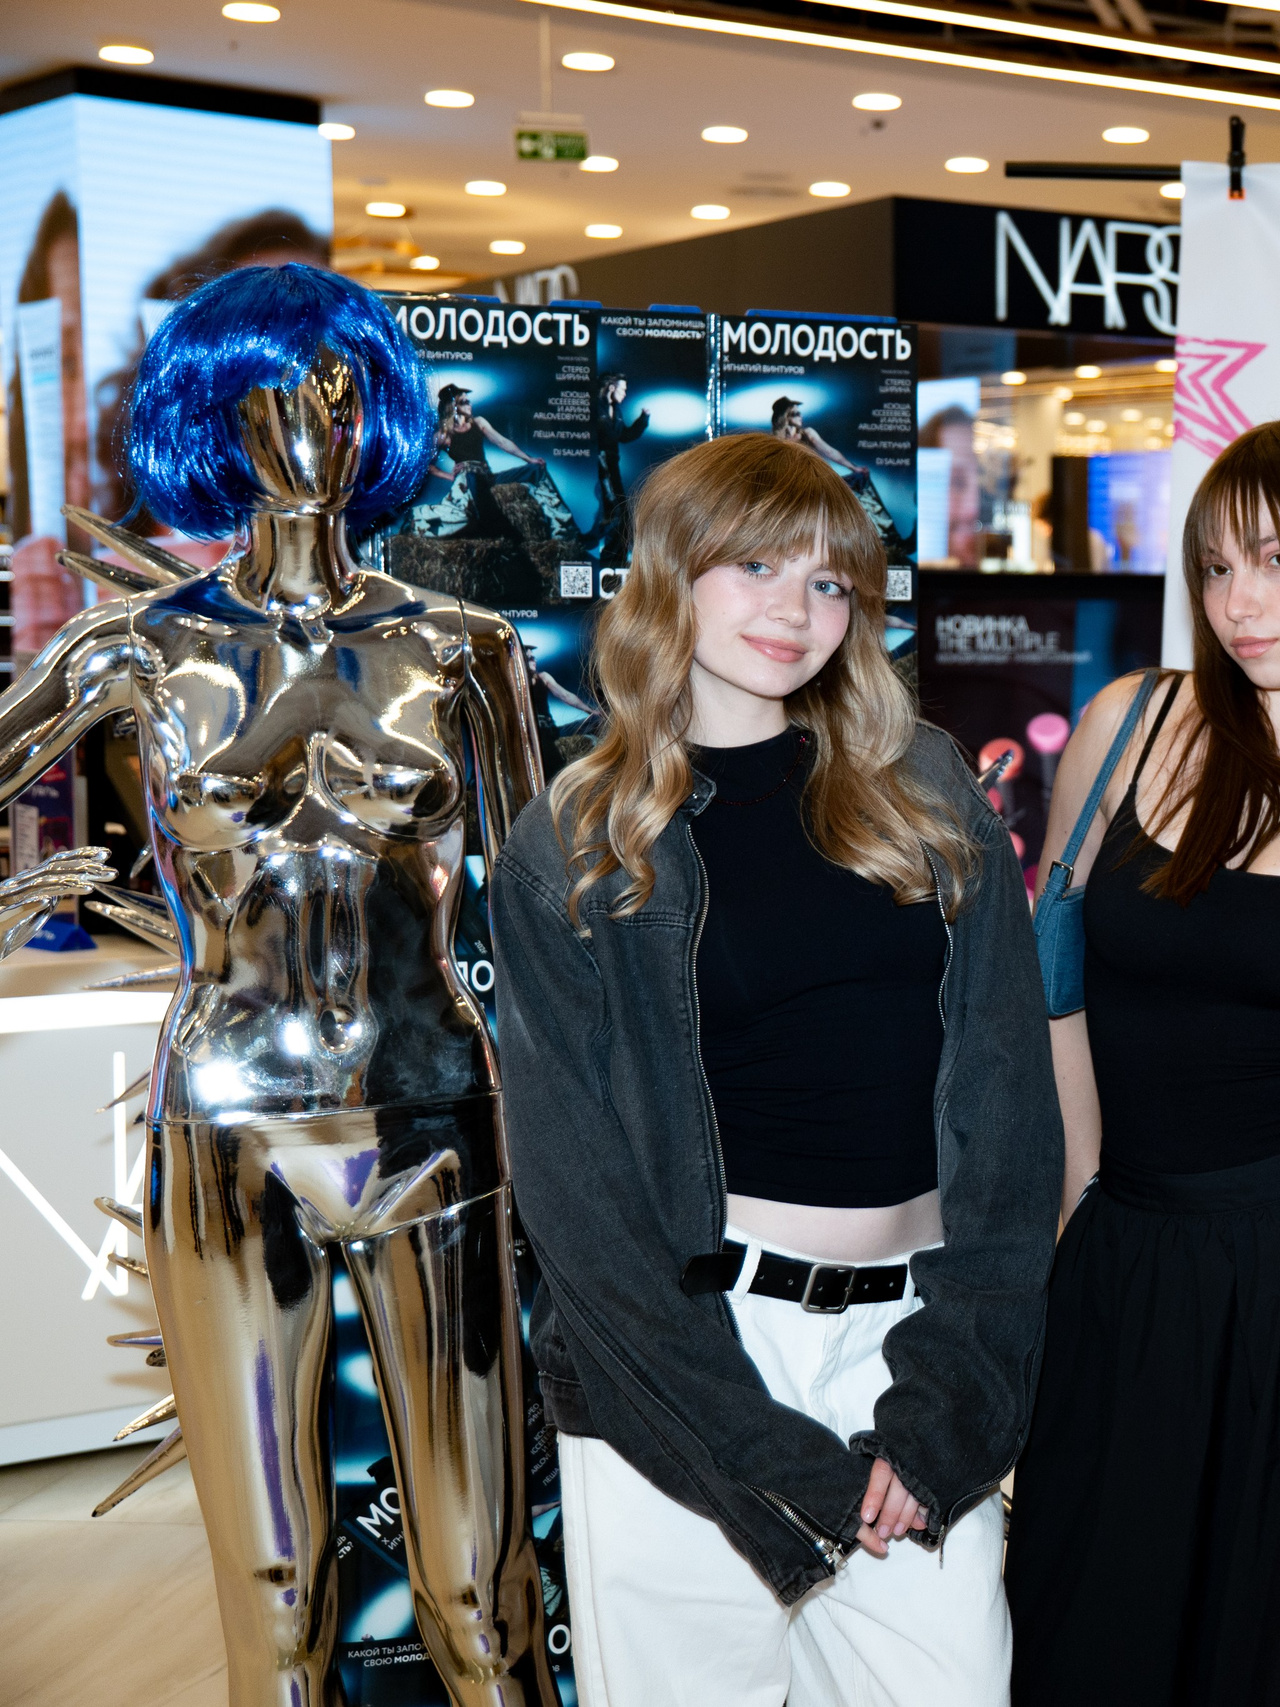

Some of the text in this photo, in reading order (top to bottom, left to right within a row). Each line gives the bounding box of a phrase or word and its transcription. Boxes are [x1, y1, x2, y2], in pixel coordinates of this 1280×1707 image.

[601, 316, 705, 329] КАКОЙ ТЫ ЗАПОМНИШЬ
[616, 327, 706, 339] СВОЮ МОЛОДОСТЬ?
[723, 321, 912, 363] МОЛОДОСТЬ
[562, 365, 590, 373] СТЕРЕО
[762, 365, 805, 374] ВИНТУРОВ
[347, 1647, 380, 1658] КАКОЙ
[382, 1646, 395, 1655] ТЫ
[364, 1657, 392, 1668] СВОЮ
